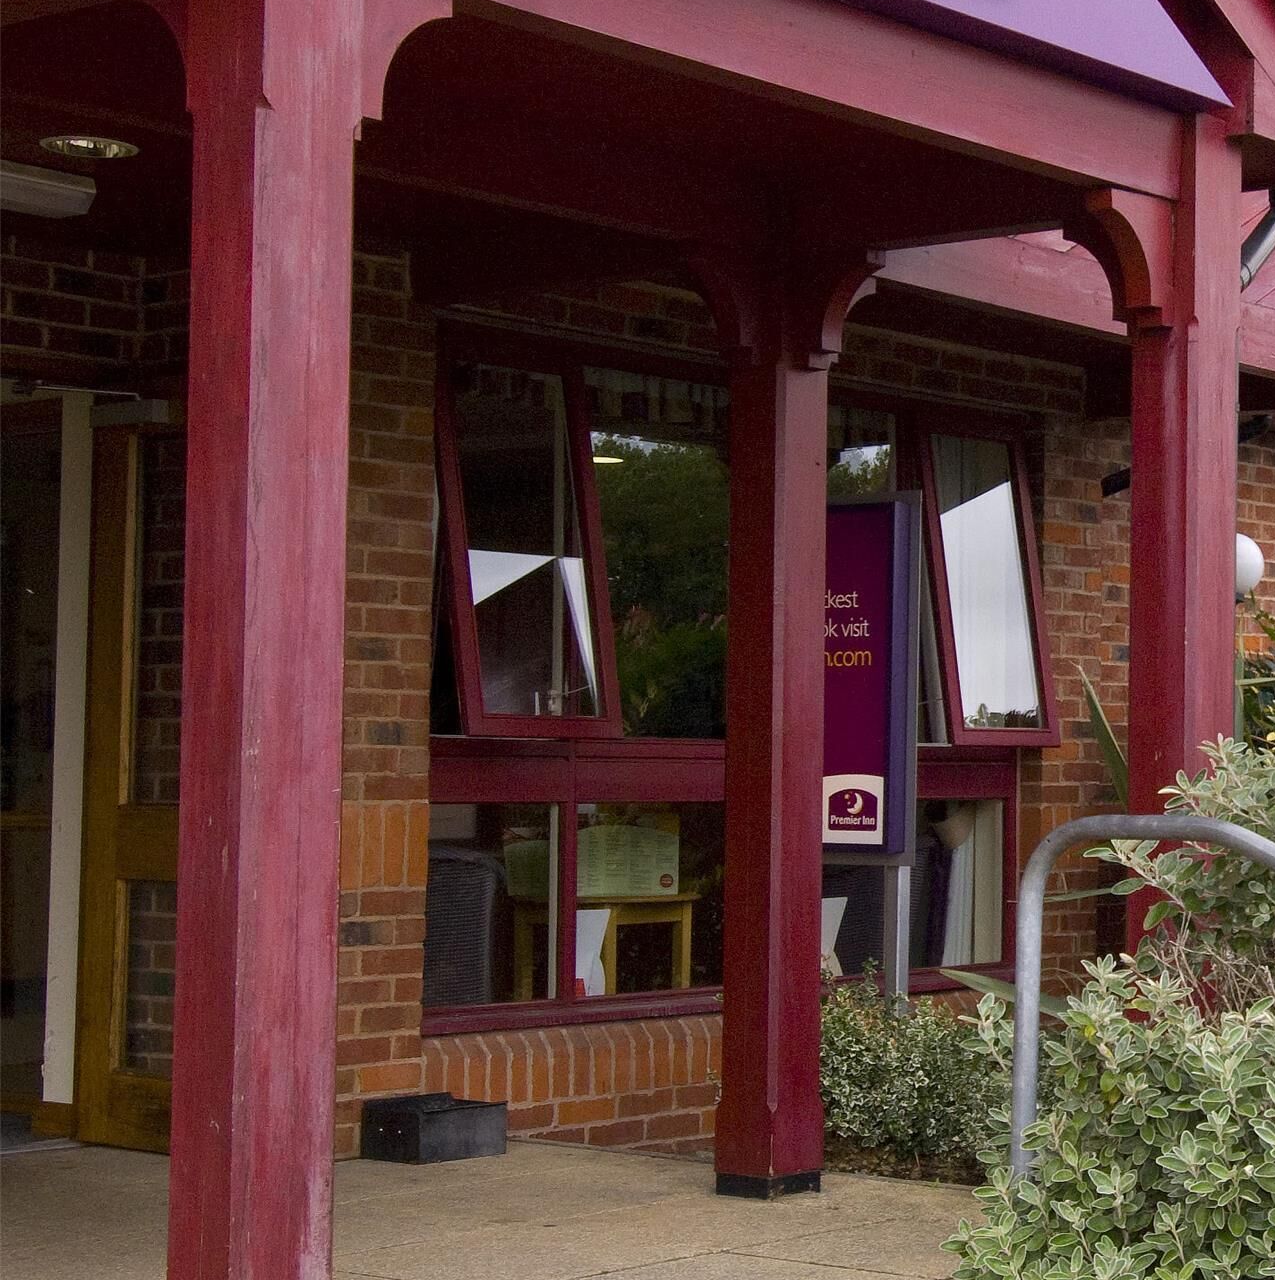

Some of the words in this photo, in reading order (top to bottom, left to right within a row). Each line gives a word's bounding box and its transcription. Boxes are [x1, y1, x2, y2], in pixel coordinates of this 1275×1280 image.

[841, 617, 870, 637] visit
[830, 815, 861, 825] Premier
[862, 816, 875, 825] Inn
